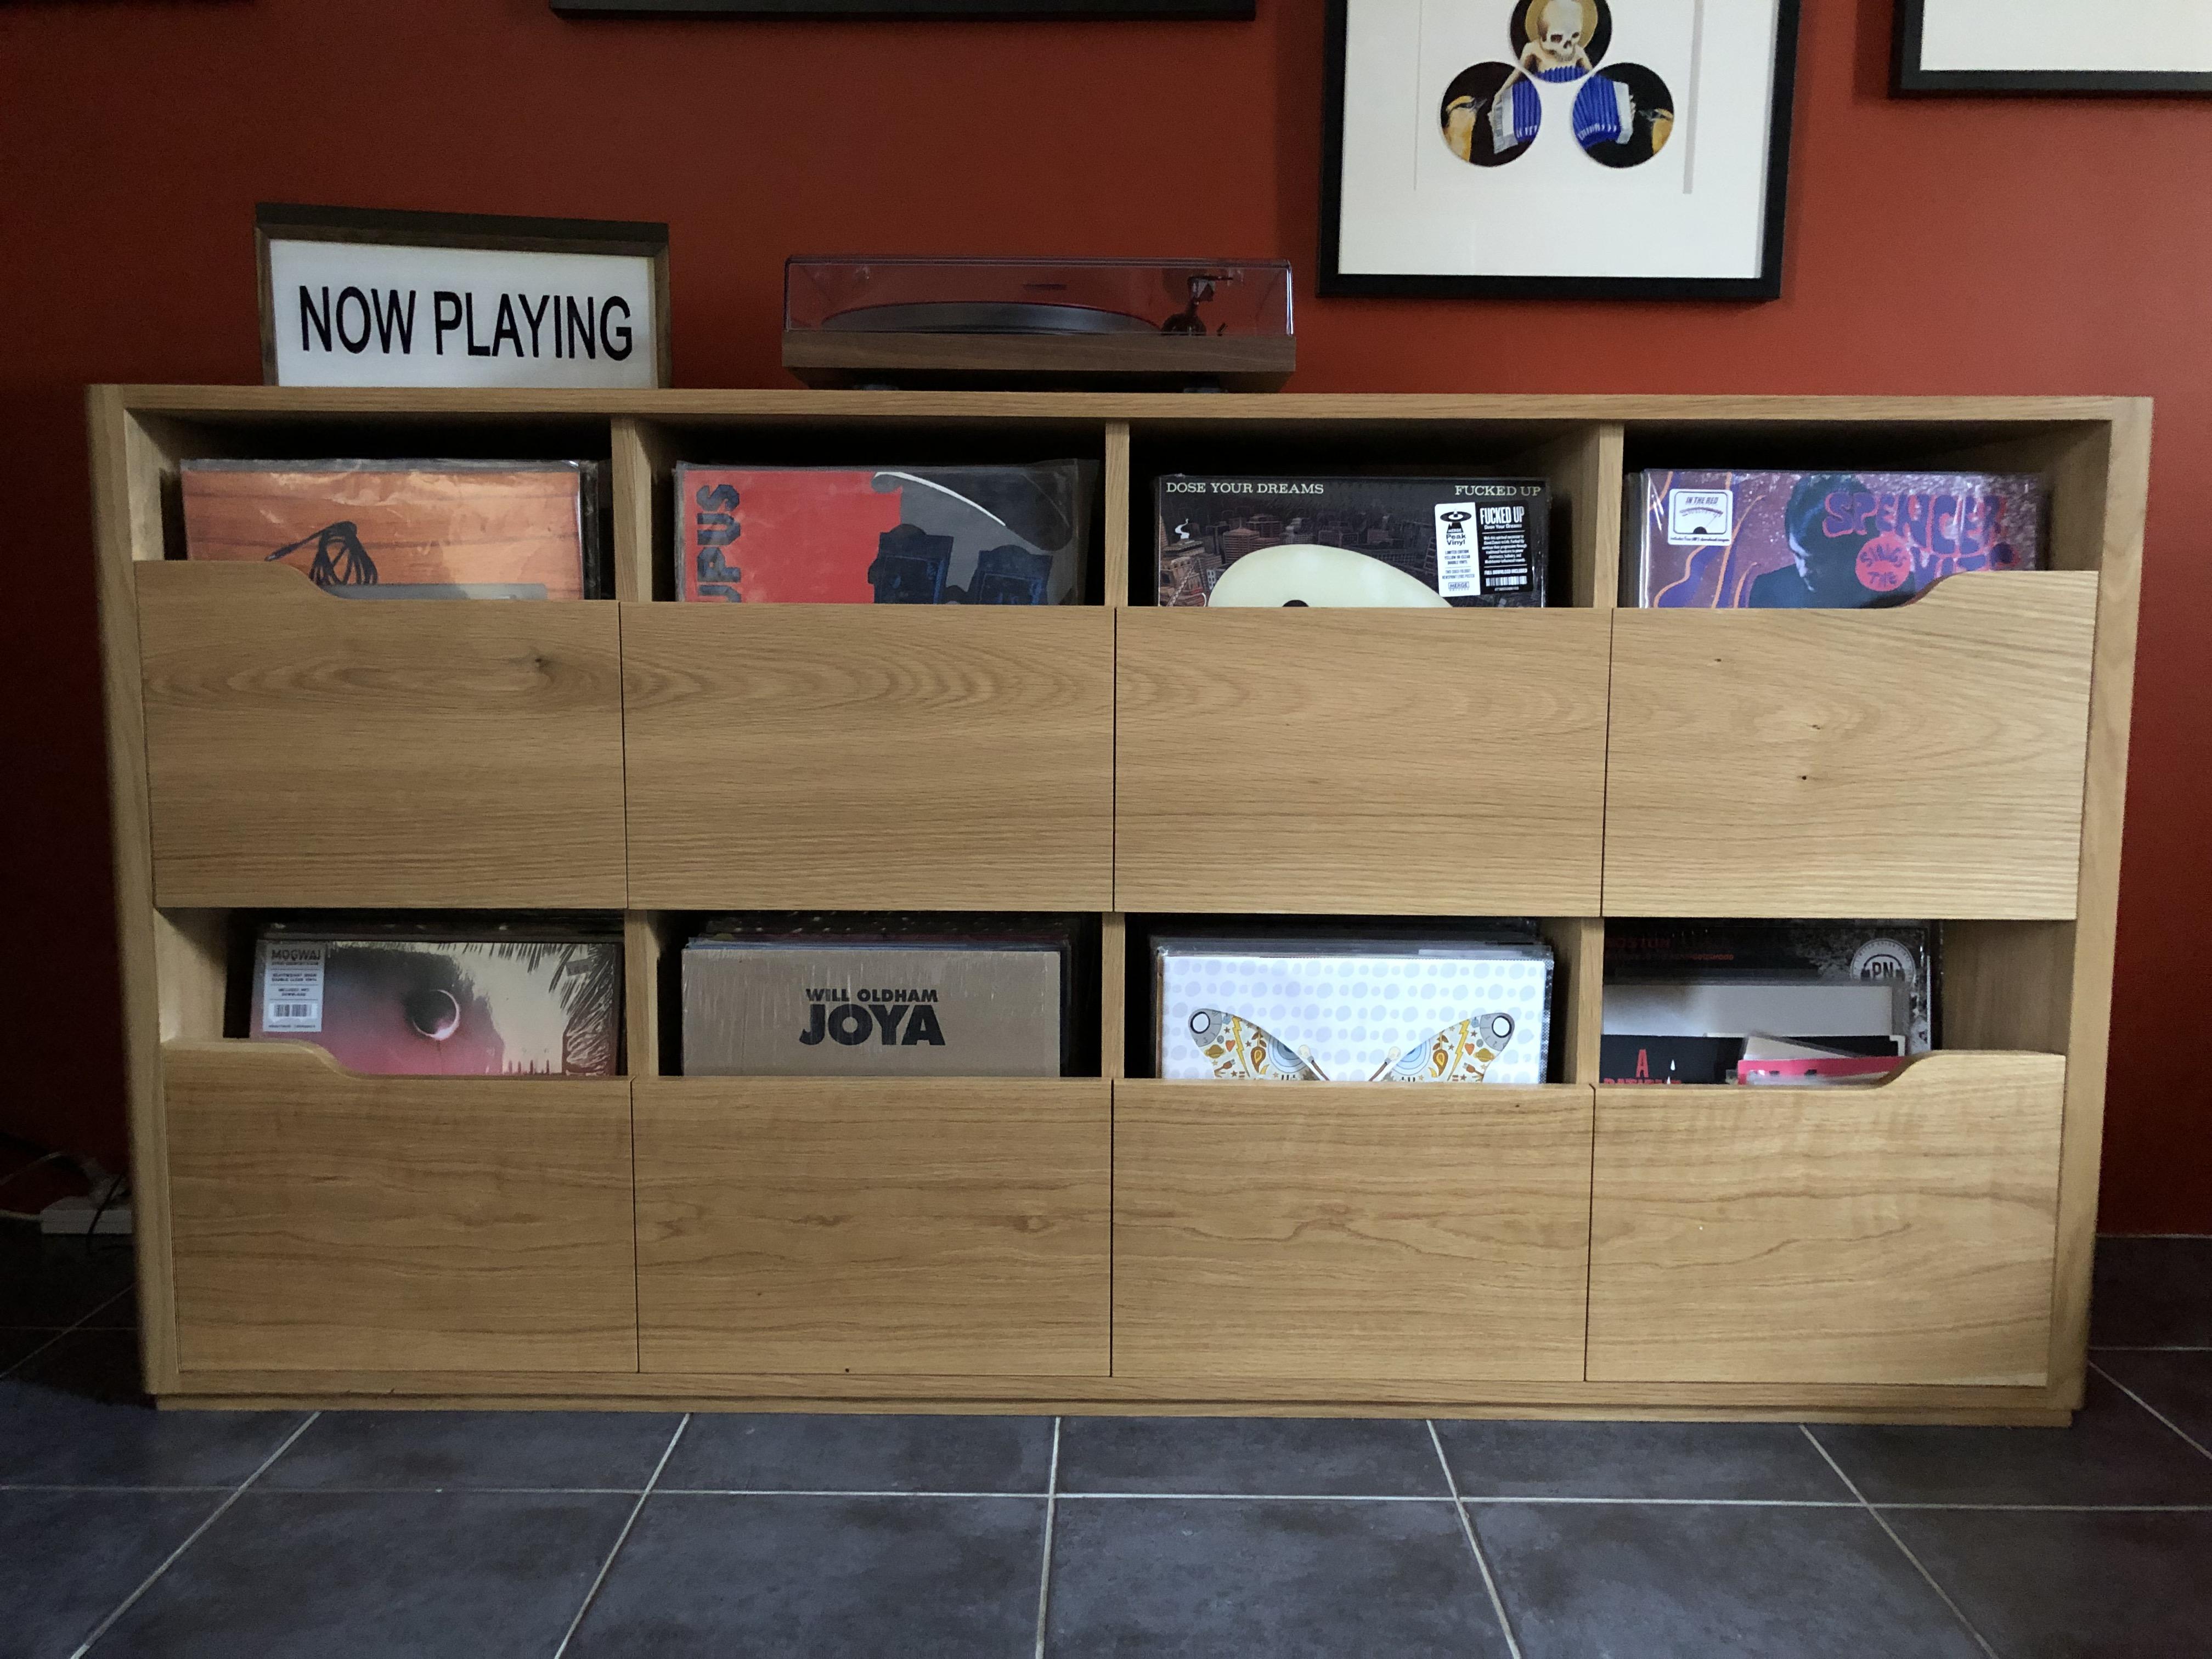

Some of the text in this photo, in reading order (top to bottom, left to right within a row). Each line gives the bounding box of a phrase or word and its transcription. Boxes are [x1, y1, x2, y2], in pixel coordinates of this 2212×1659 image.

[299, 285, 633, 361] NOW PLAYING
[1166, 482, 1324, 494] DOSE YOUR DREAMS
[1454, 485, 1541, 496] FUCKED UP
[1685, 496, 1694, 505] IN
[1694, 496, 1706, 505] THE
[1480, 506, 1525, 524] FUCKED UP
[1867, 572, 1897, 588] THE
[272, 949, 321, 961] MOGWAI
[805, 989, 938, 1002] WILL OLDHAM
[799, 1003, 946, 1046] JOYA
[1635, 1049, 1649, 1078] A
